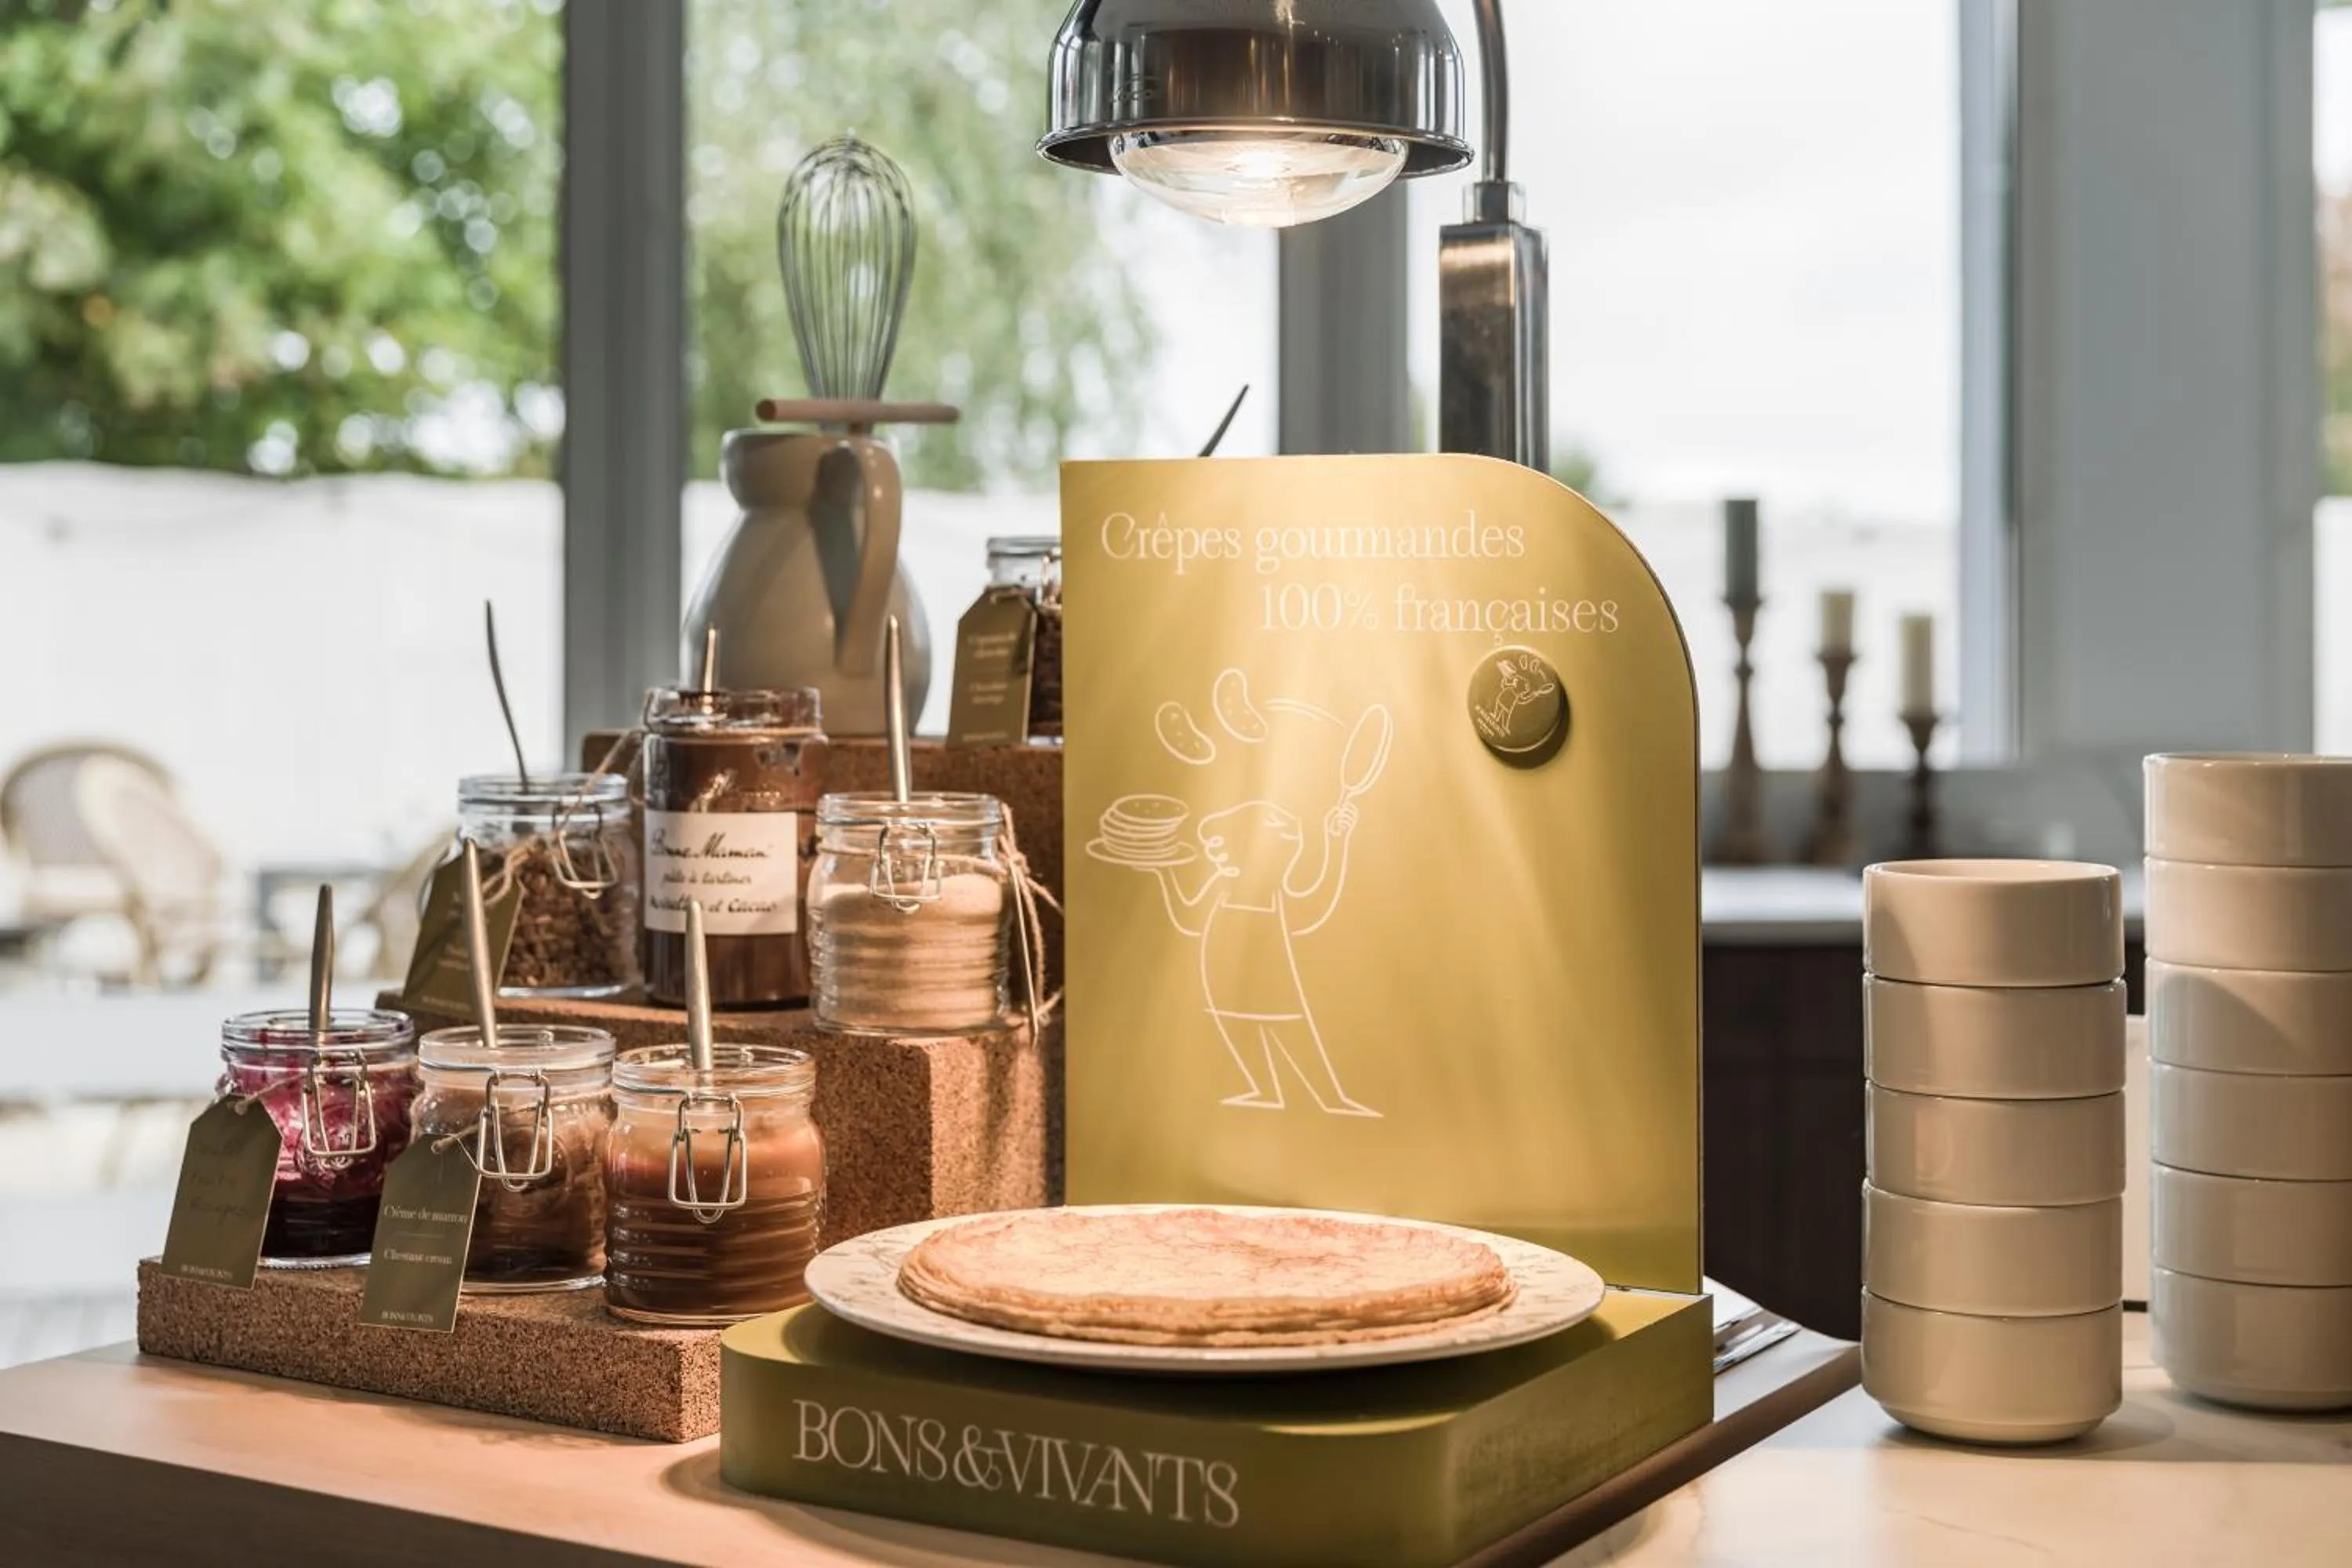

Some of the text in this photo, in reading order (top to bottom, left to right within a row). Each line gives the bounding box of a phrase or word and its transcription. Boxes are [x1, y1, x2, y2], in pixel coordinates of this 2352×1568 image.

[1101, 510, 1525, 575] Crêpes gourmandes
[1259, 581, 1619, 645] 100% françaises
[792, 1399, 1240, 1528] BONS&VIVANTS
